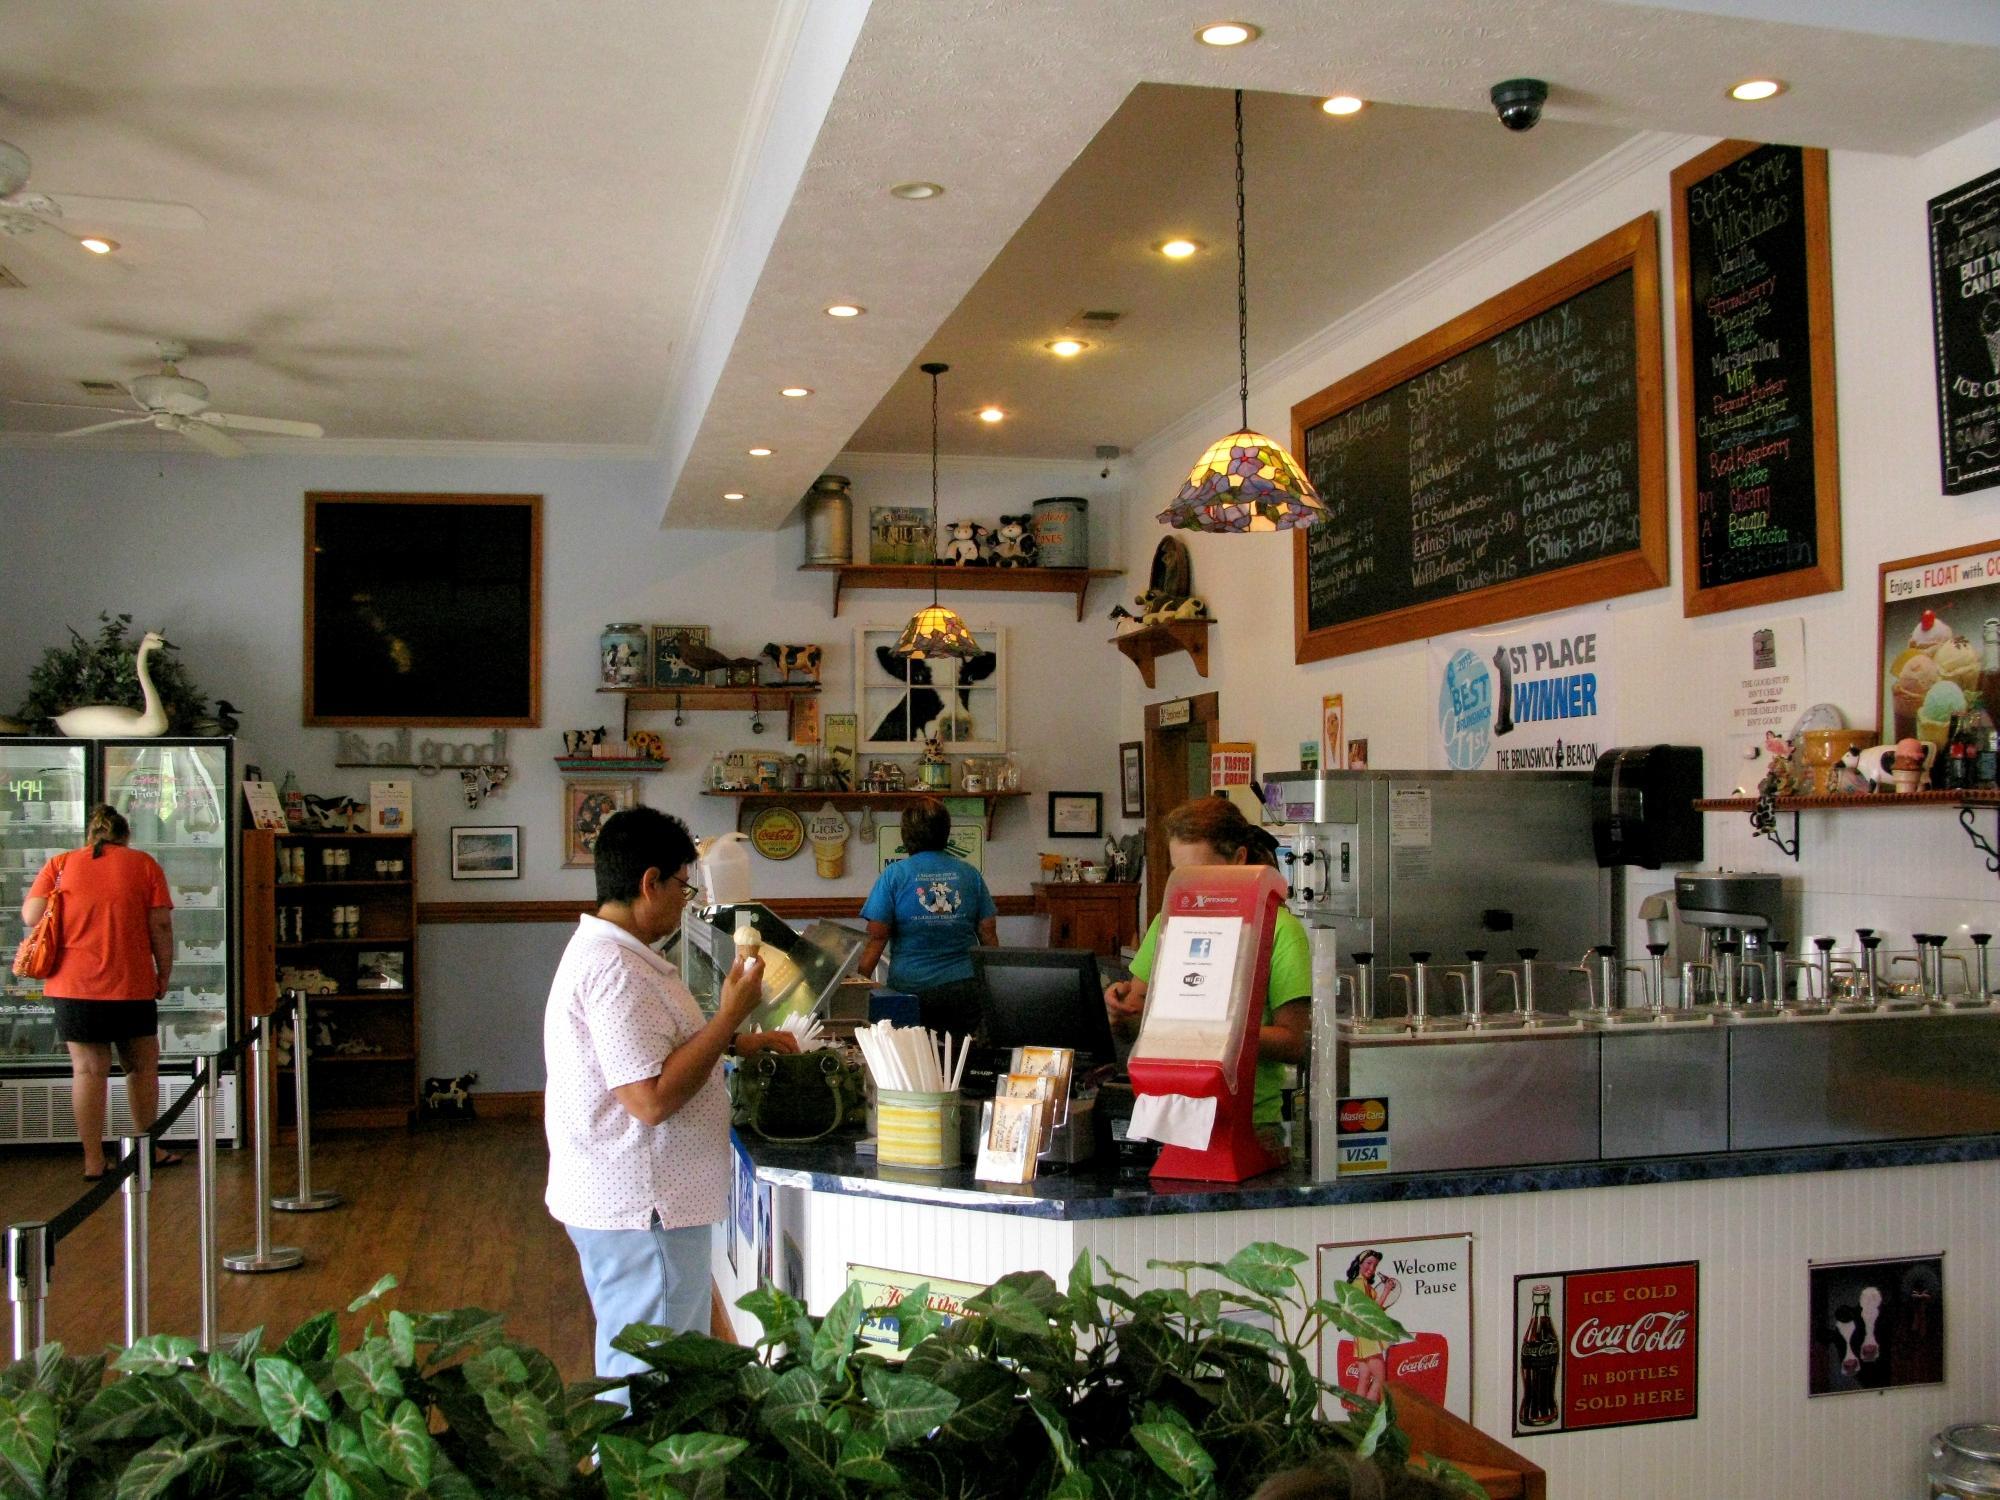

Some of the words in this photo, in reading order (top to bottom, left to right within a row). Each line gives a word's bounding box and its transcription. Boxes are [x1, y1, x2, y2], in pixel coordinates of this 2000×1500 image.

[1960, 255, 1986, 282] BUT
[1953, 373, 1980, 399] ICE
[1889, 578, 1913, 596] Enjoy
[1915, 579, 1922, 589] a
[1924, 564, 1960, 588] FLOAT
[1962, 562, 1985, 580] with
[1531, 633, 1597, 672] PLACE
[1452, 673, 1489, 717] BEST
[1514, 672, 1597, 723] WINNER
[1496, 749, 1510, 770] THE
[1511, 746, 1554, 770] BRUNSWICK
[1566, 743, 1598, 767] BEACON
[758, 828, 800, 842] Coca-Cola
[811, 823, 845, 835] LICKS
[1340, 1110, 1385, 1122] MasterCard
[1346, 1147, 1379, 1162] VISA
[1392, 1259, 1457, 1275] Welcome
[1415, 1279, 1457, 1296] Pause
[1583, 1290, 1616, 1305] ICE
[1623, 1284, 1677, 1301] COLD
[1570, 1310, 1690, 1358] Coca-Cola
[1397, 1353, 1441, 1376] Coca-Cola
[1582, 1373, 1598, 1386] IN
[1605, 1365, 1679, 1384] BOTTLES
[1574, 1394, 1627, 1412] SOLD
[1633, 1388, 1686, 1406] HERE
